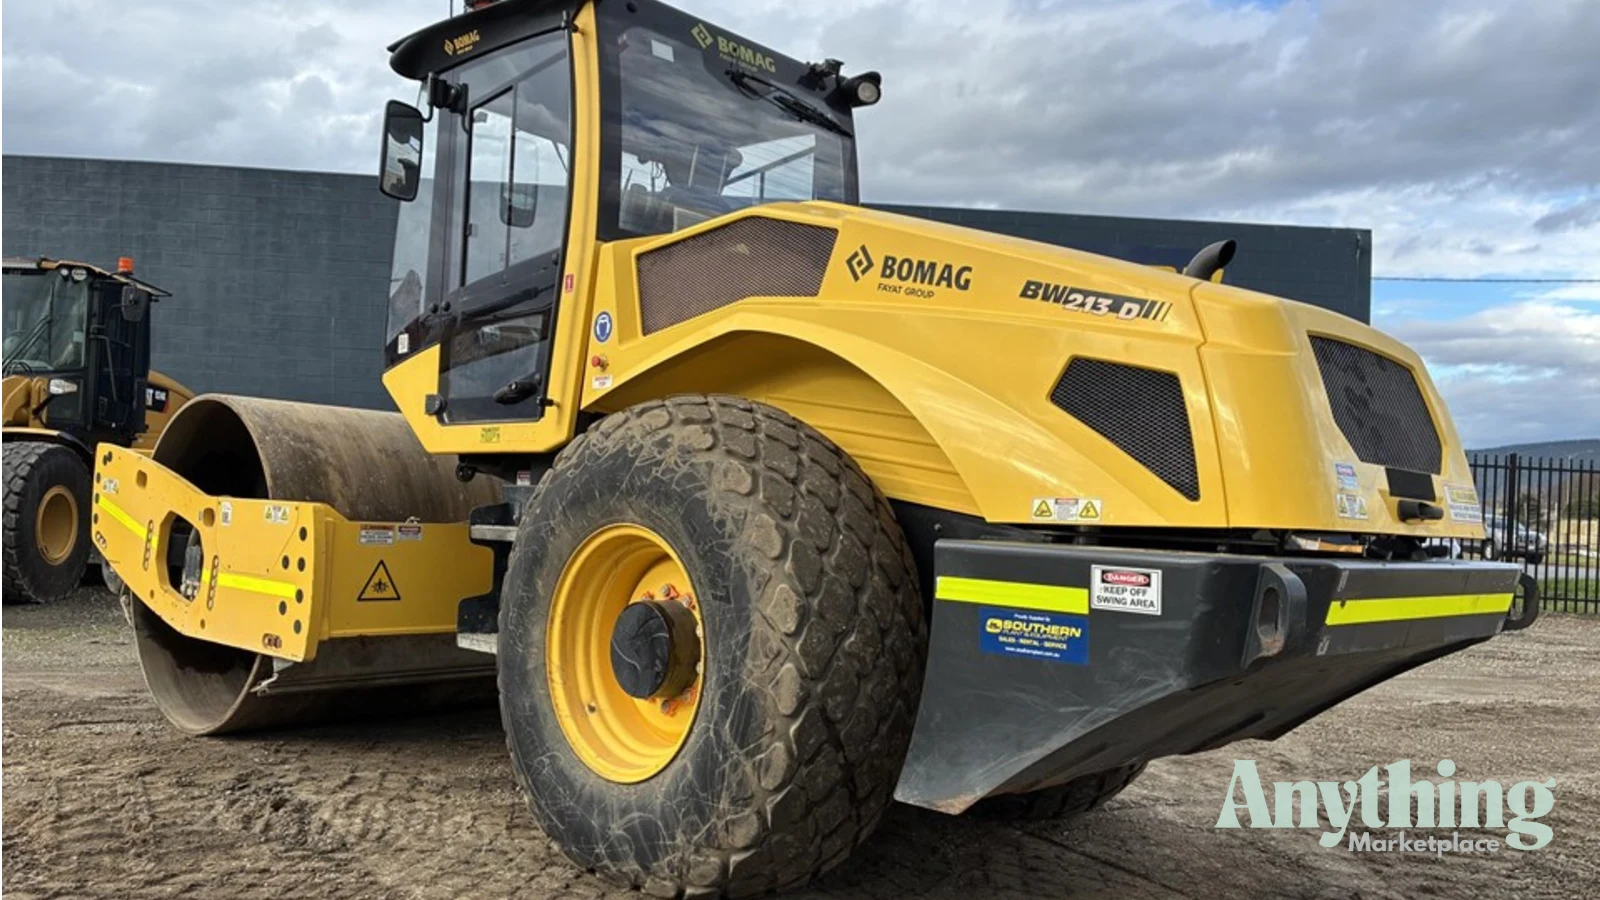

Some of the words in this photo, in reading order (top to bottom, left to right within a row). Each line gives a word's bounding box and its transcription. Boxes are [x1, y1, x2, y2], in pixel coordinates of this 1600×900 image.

[717, 35, 776, 73] BOMAG
[880, 254, 973, 291] BOMAG
[877, 282, 903, 294] FAYAT
[904, 287, 935, 299] GROUP
[1108, 572, 1145, 584] DANGER
[1103, 586, 1127, 595] KEEP
[1129, 587, 1148, 598] OFF
[1096, 594, 1128, 606] SWING
[1129, 597, 1155, 609] AREA
[1002, 620, 1081, 637] SOUTHERN
[1002, 629, 1023, 637] PLANT
[998, 635, 1016, 643] SALES
[1019, 638, 1040, 647] RENTAL
[1043, 641, 1067, 650] SERVICE
